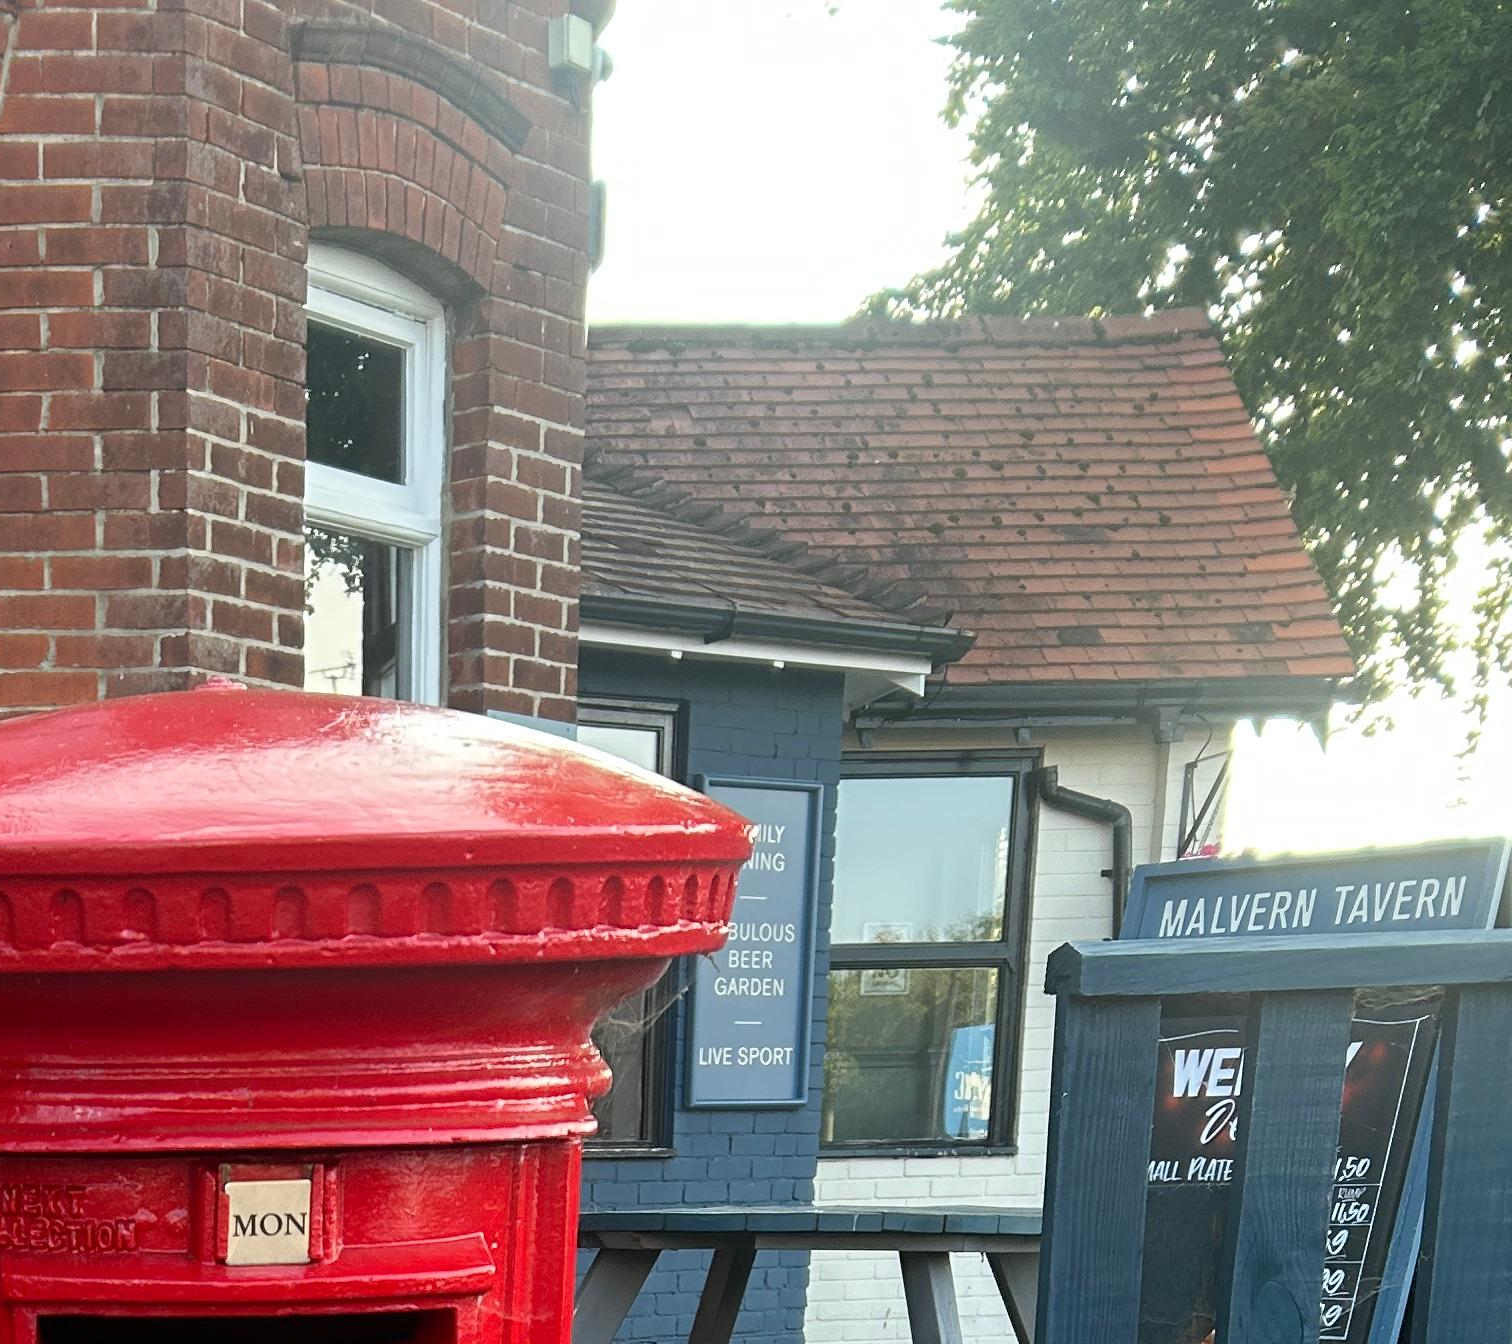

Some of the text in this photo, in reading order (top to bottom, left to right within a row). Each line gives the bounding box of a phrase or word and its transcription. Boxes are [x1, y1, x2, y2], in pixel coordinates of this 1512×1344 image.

[742, 852, 786, 872] NING
[1158, 875, 1467, 938] MALVERN TAVERN
[728, 922, 795, 943] BULOUS
[728, 951, 773, 969] BEER
[714, 977, 785, 996] GARDEN
[699, 1047, 793, 1066] LIVE SPORT
[232, 1211, 308, 1239] MON
